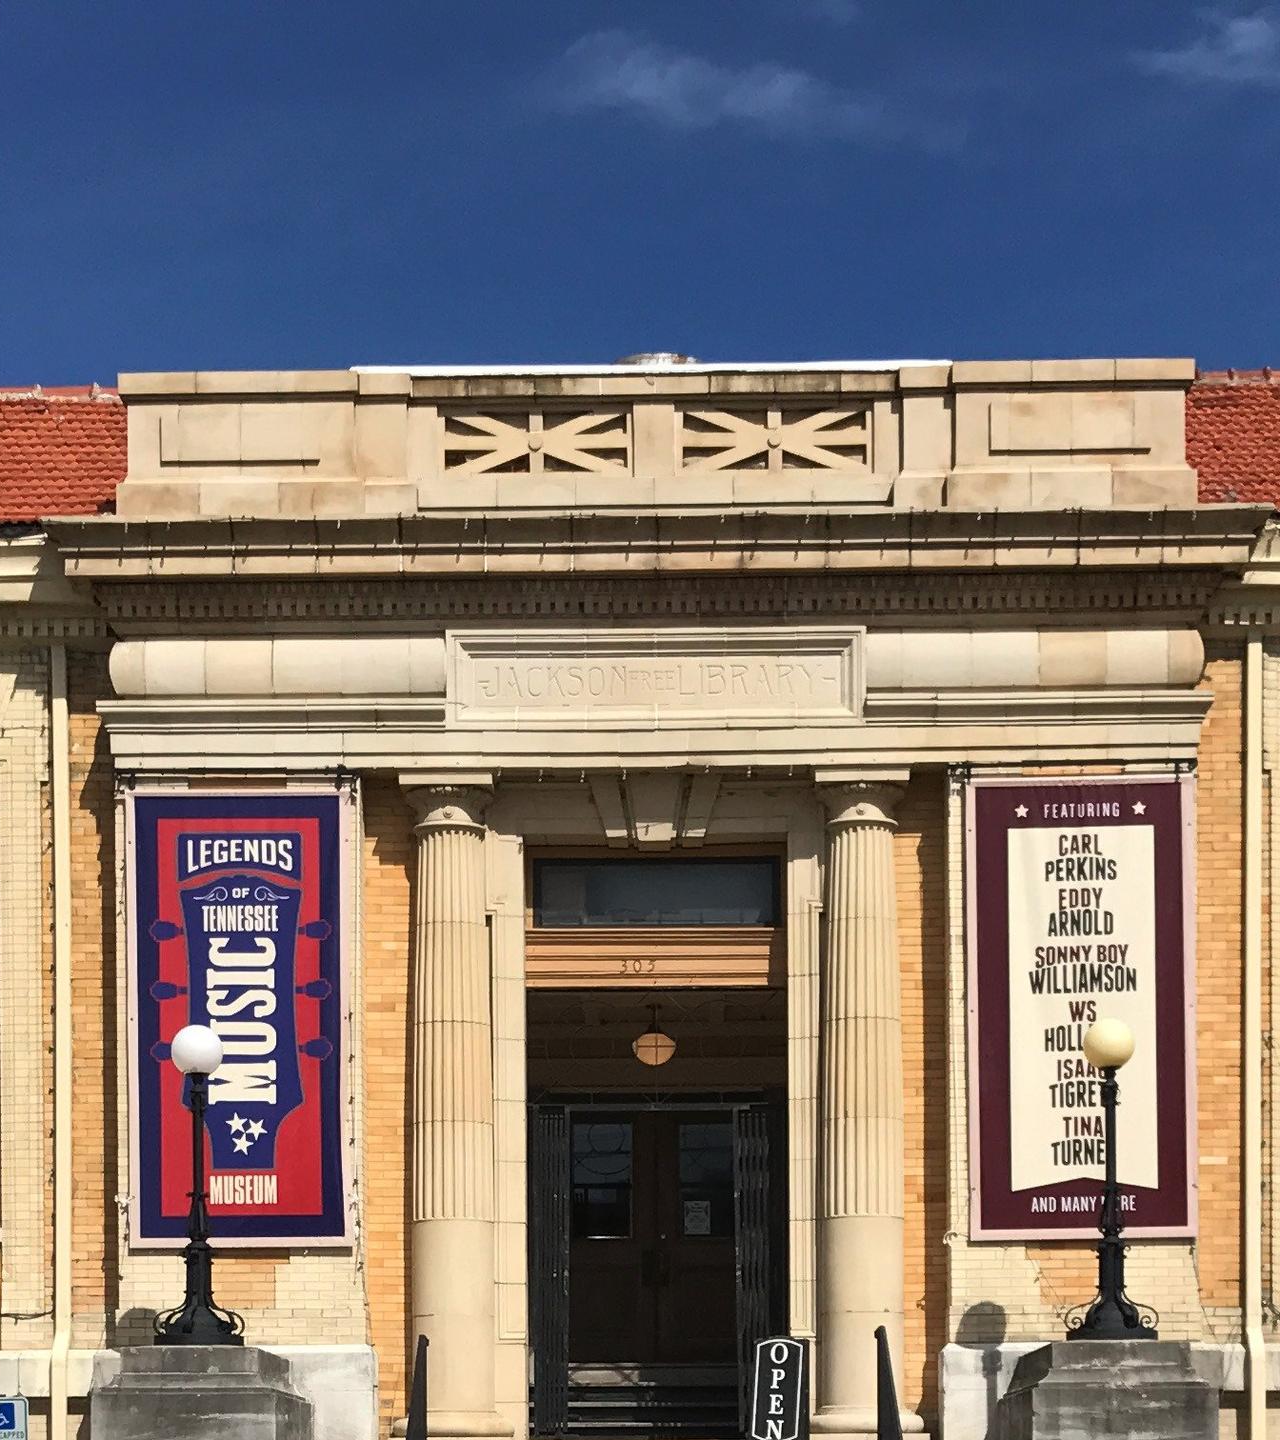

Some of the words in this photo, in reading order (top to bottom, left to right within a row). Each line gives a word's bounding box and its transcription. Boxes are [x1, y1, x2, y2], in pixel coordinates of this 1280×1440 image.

[628, 669, 676, 691] FREE
[1043, 802, 1120, 819] FEATURING
[187, 839, 293, 873] LEGENDS
[1058, 833, 1103, 857] CARL
[1044, 856, 1118, 882] PERKINS
[231, 887, 250, 899] OF
[1058, 887, 1103, 911] EDDY
[201, 904, 279, 932] TENNESSEE
[1047, 909, 1115, 937] ARNOLD
[620, 958, 657, 974] 305
[1034, 944, 1092, 970] SONNY
[1096, 943, 1129, 967] BOY
[1028, 964, 1138, 994] WILLIAMSON
[206, 936, 277, 1106] MUSIC
[1068, 1000, 1097, 1023] WS
[1049, 1080, 1106, 1108] TIGRET
[1062, 1115, 1104, 1138] TINA
[1051, 1138, 1106, 1166] TURNE
[209, 1174, 278, 1206] MUSEUM
[1031, 1196, 1057, 1213] AND
[1061, 1195, 1097, 1213] MANY
[765, 1342, 789, 1440] OPEN
